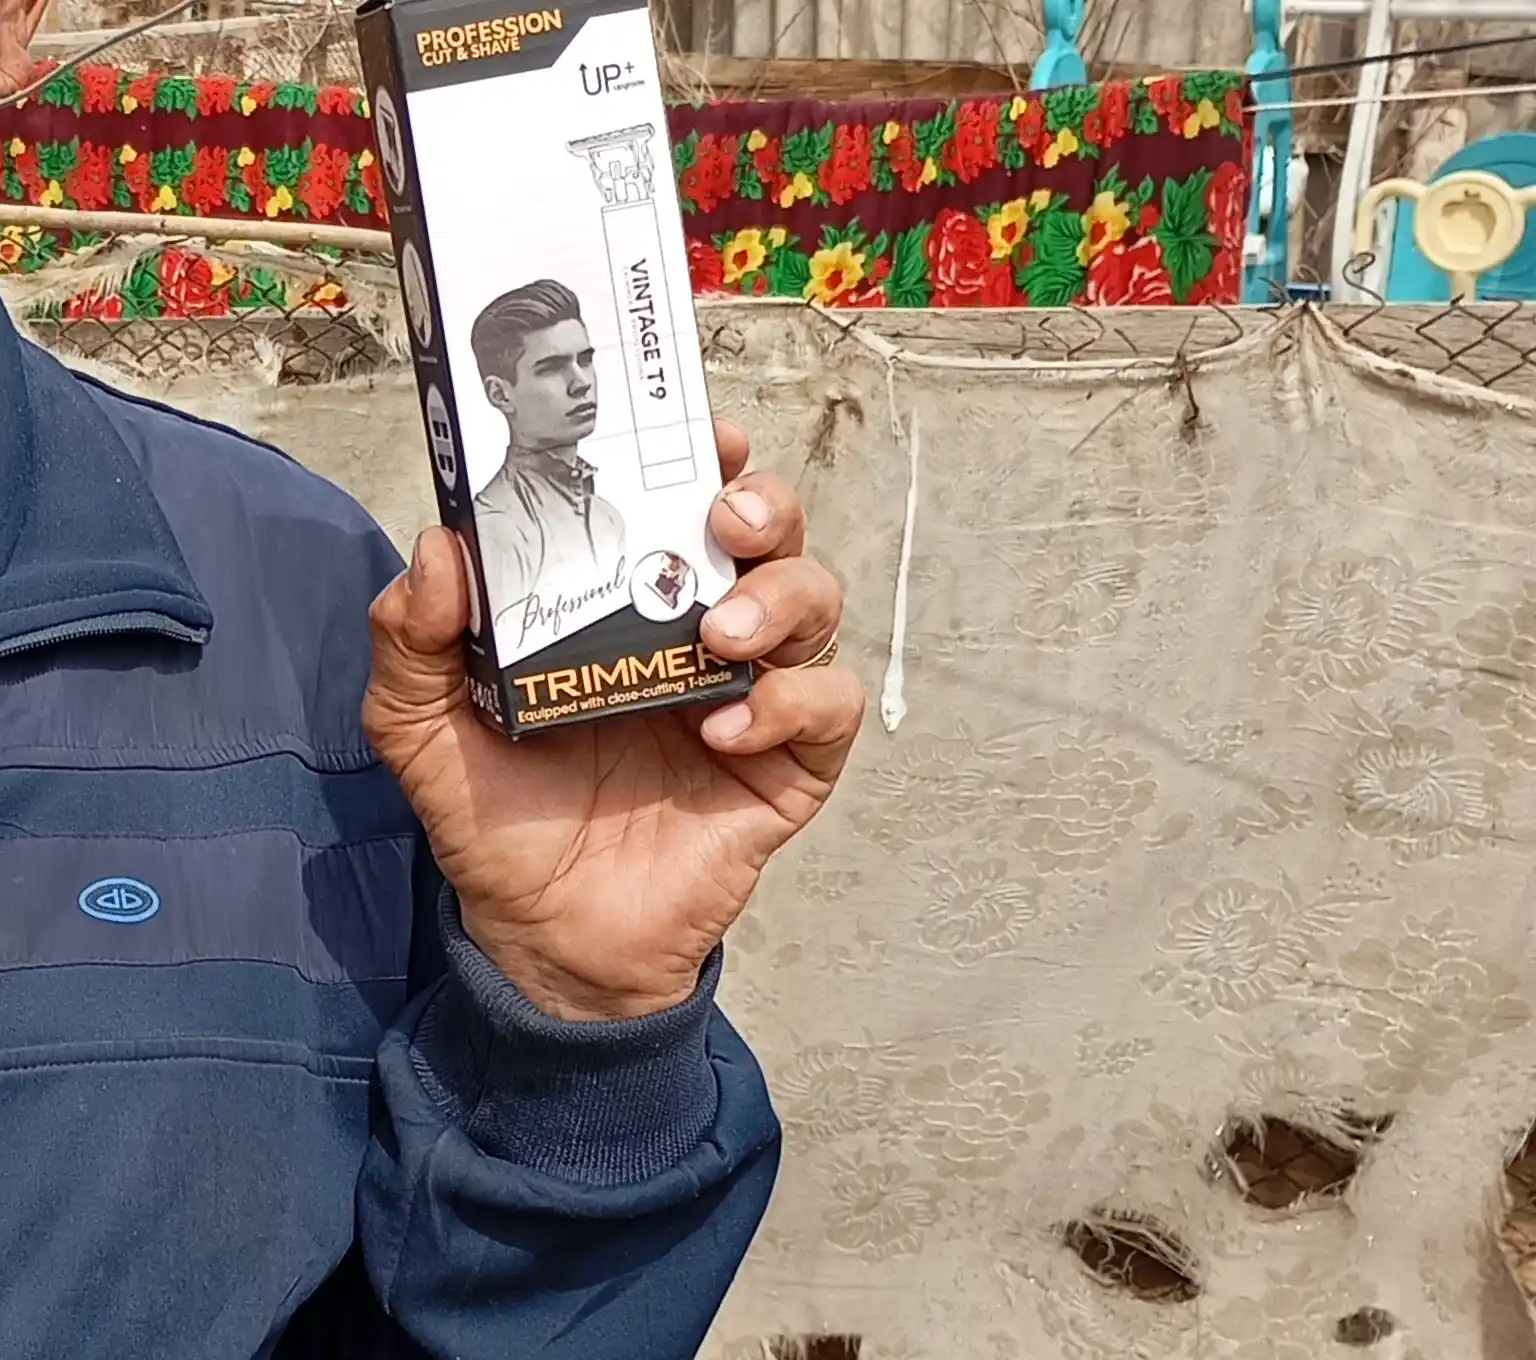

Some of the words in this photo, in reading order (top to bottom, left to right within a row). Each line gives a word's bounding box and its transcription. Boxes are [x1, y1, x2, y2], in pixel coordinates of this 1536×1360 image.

[416, 8, 563, 53] PROFESSION
[421, 47, 453, 67] CUT
[456, 48, 469, 61] &
[471, 36, 521, 59] SHAVE
[628, 257, 662, 362] VINTAGE
[647, 367, 667, 400] T9
[494, 554, 627, 650] Professional
[517, 700, 578, 724] Equipped
[580, 693, 605, 710] with
[607, 679, 686, 706] close-cutting
[687, 669, 733, 690] T-blade
